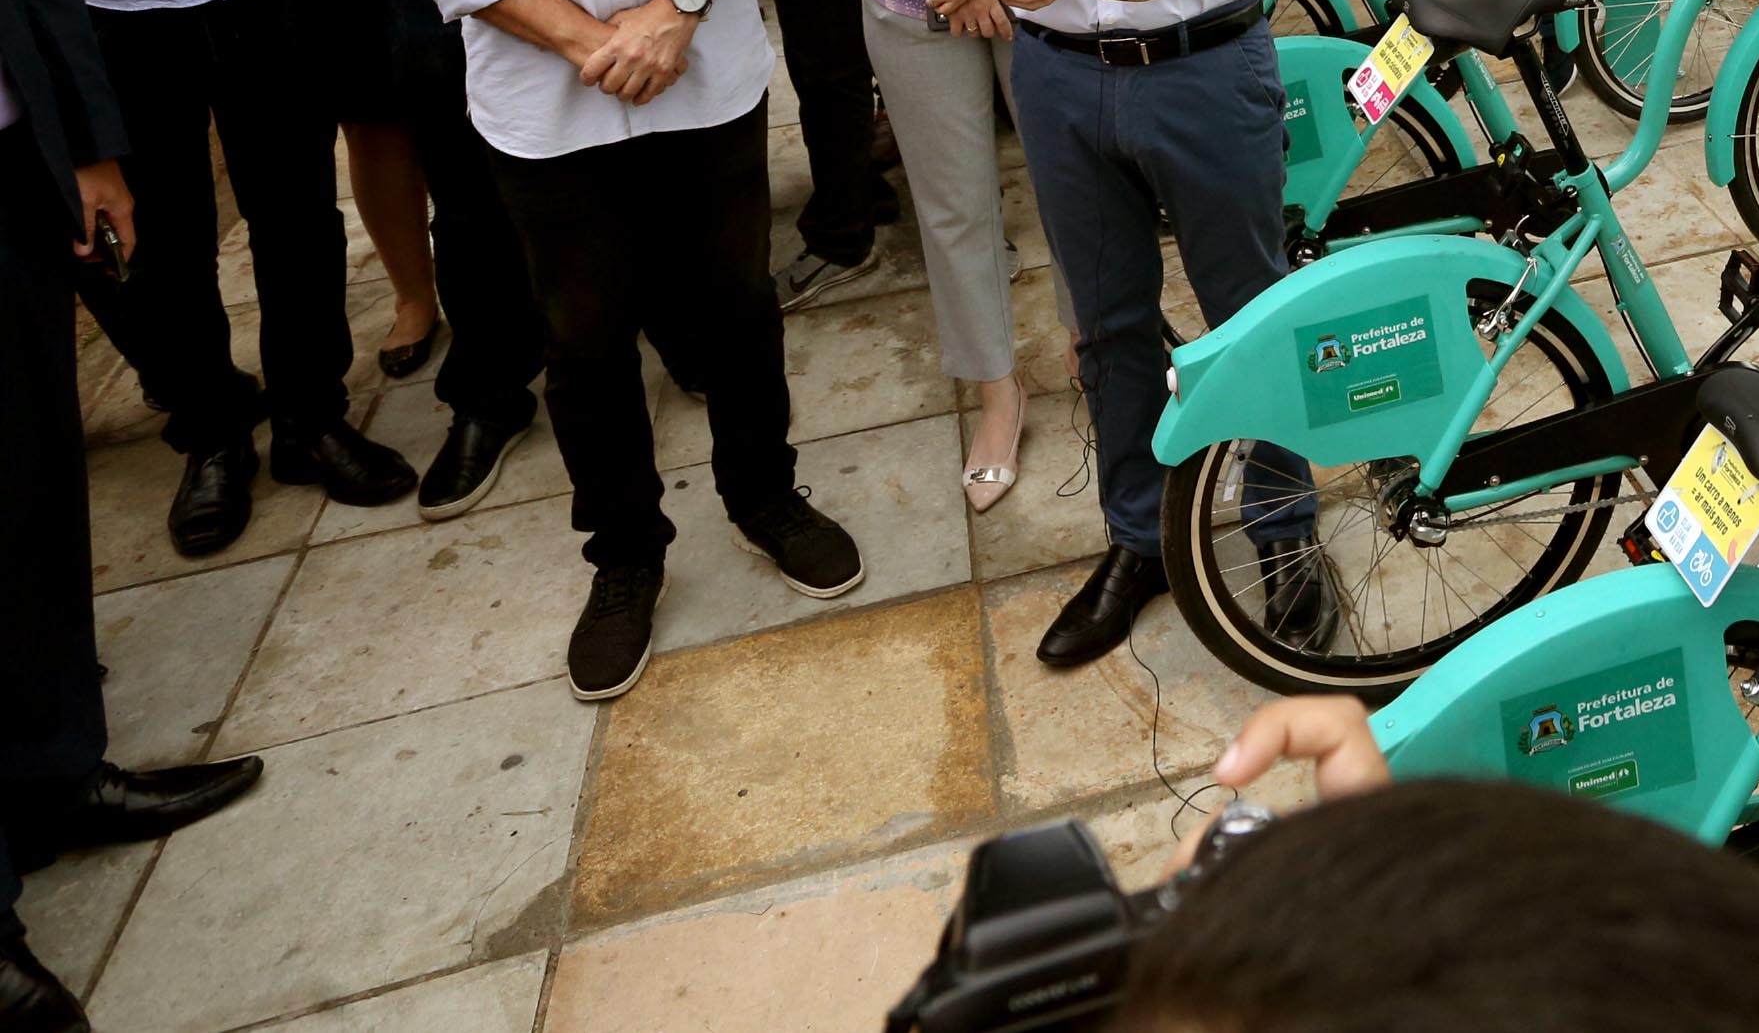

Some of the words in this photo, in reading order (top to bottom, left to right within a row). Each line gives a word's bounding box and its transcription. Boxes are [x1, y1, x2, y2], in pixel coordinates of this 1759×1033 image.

[1292, 97, 1305, 107] de
[1351, 322, 1407, 343] Prefeitura
[1410, 316, 1424, 327] de
[1352, 329, 1427, 358] Fortaleza
[1353, 388, 1384, 401] Unimed
[1722, 463, 1742, 486] Fortaleza
[1695, 467, 1706, 483] Um
[1703, 478, 1719, 501] carro
[1721, 500, 1742, 528] menos
[1694, 491, 1703, 503] ar
[1700, 500, 1714, 521] mais
[1711, 517, 1729, 536] puro
[1577, 683, 1652, 714] Prefeitura
[1655, 676, 1675, 690] de
[1578, 693, 1677, 732] Fortaleza
[1575, 771, 1616, 790] Unimed
